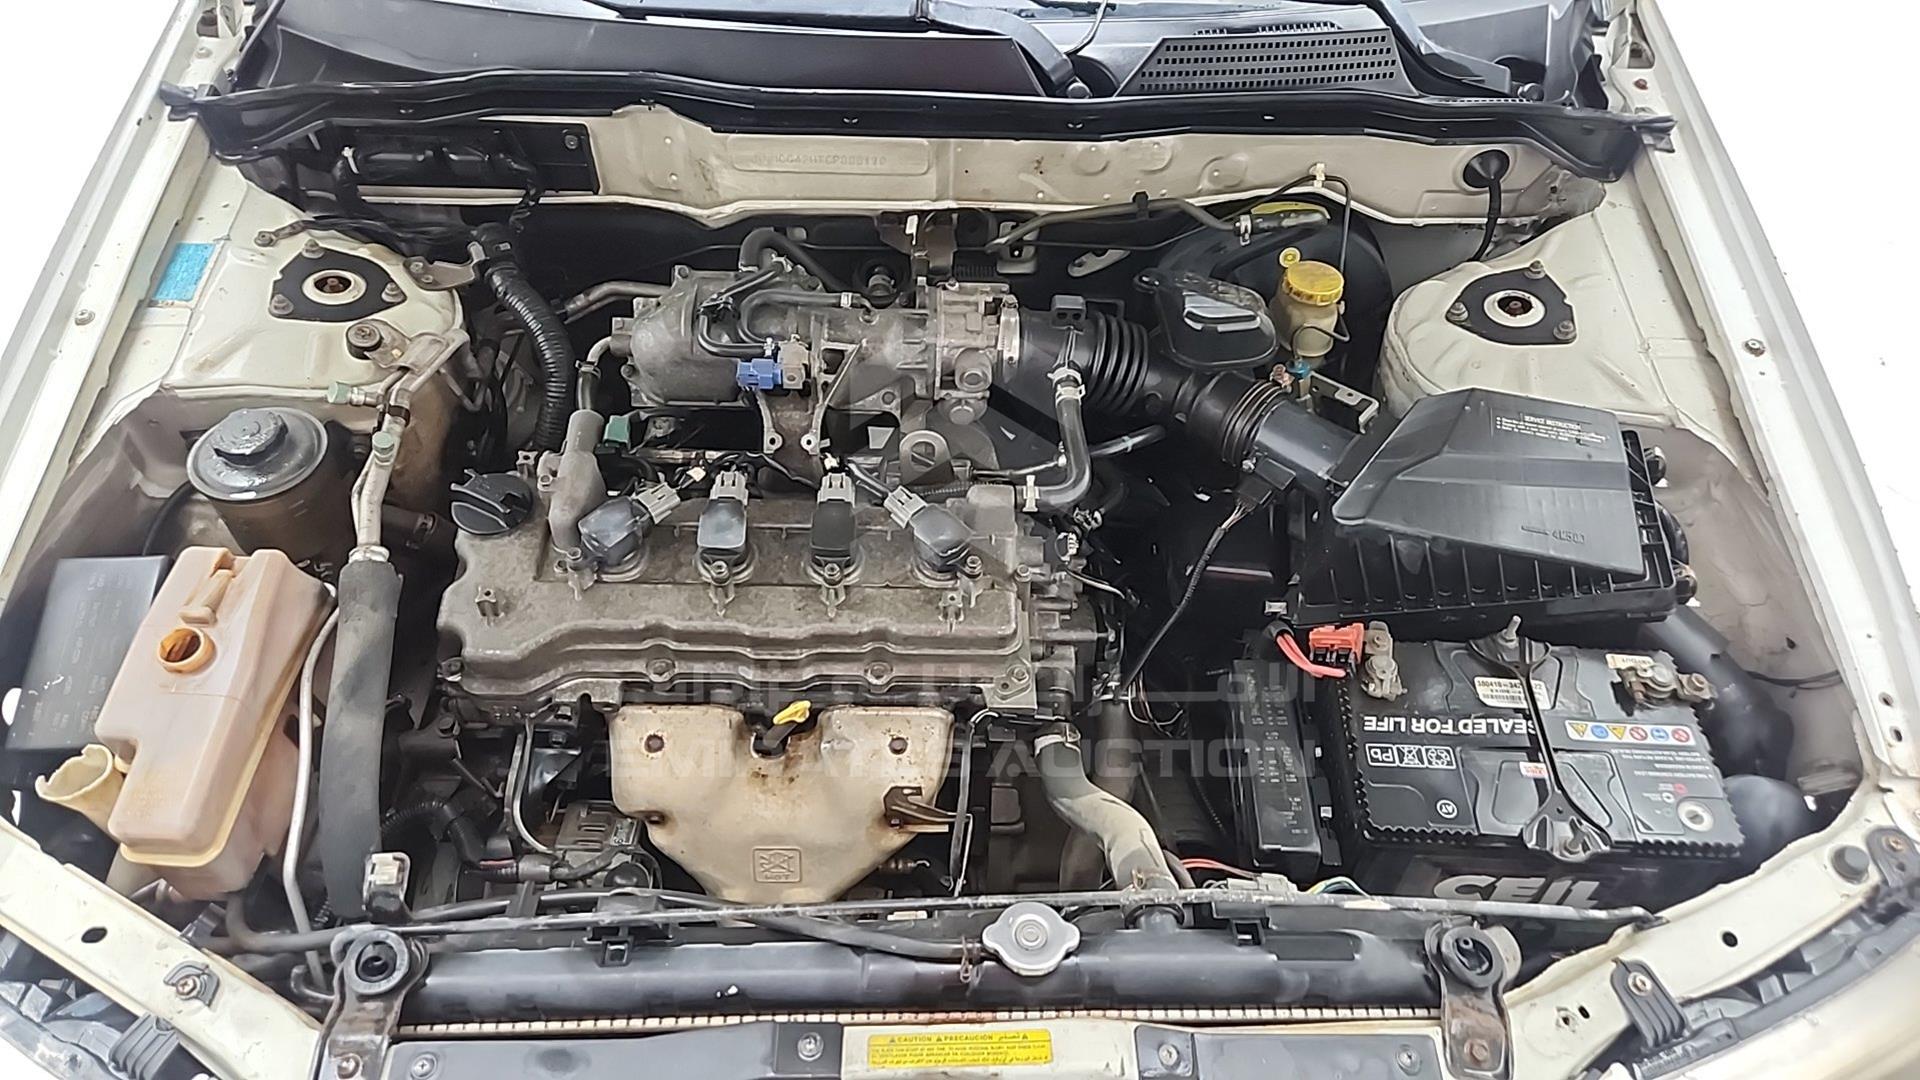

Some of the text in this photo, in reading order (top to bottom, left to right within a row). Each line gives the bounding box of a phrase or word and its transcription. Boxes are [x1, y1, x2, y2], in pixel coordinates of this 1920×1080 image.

[1363, 716, 1406, 732] LIFE
[1411, 717, 1457, 734] FOR
[1370, 748, 1394, 762] Pb
[897, 1035, 932, 1043] CAUTION
